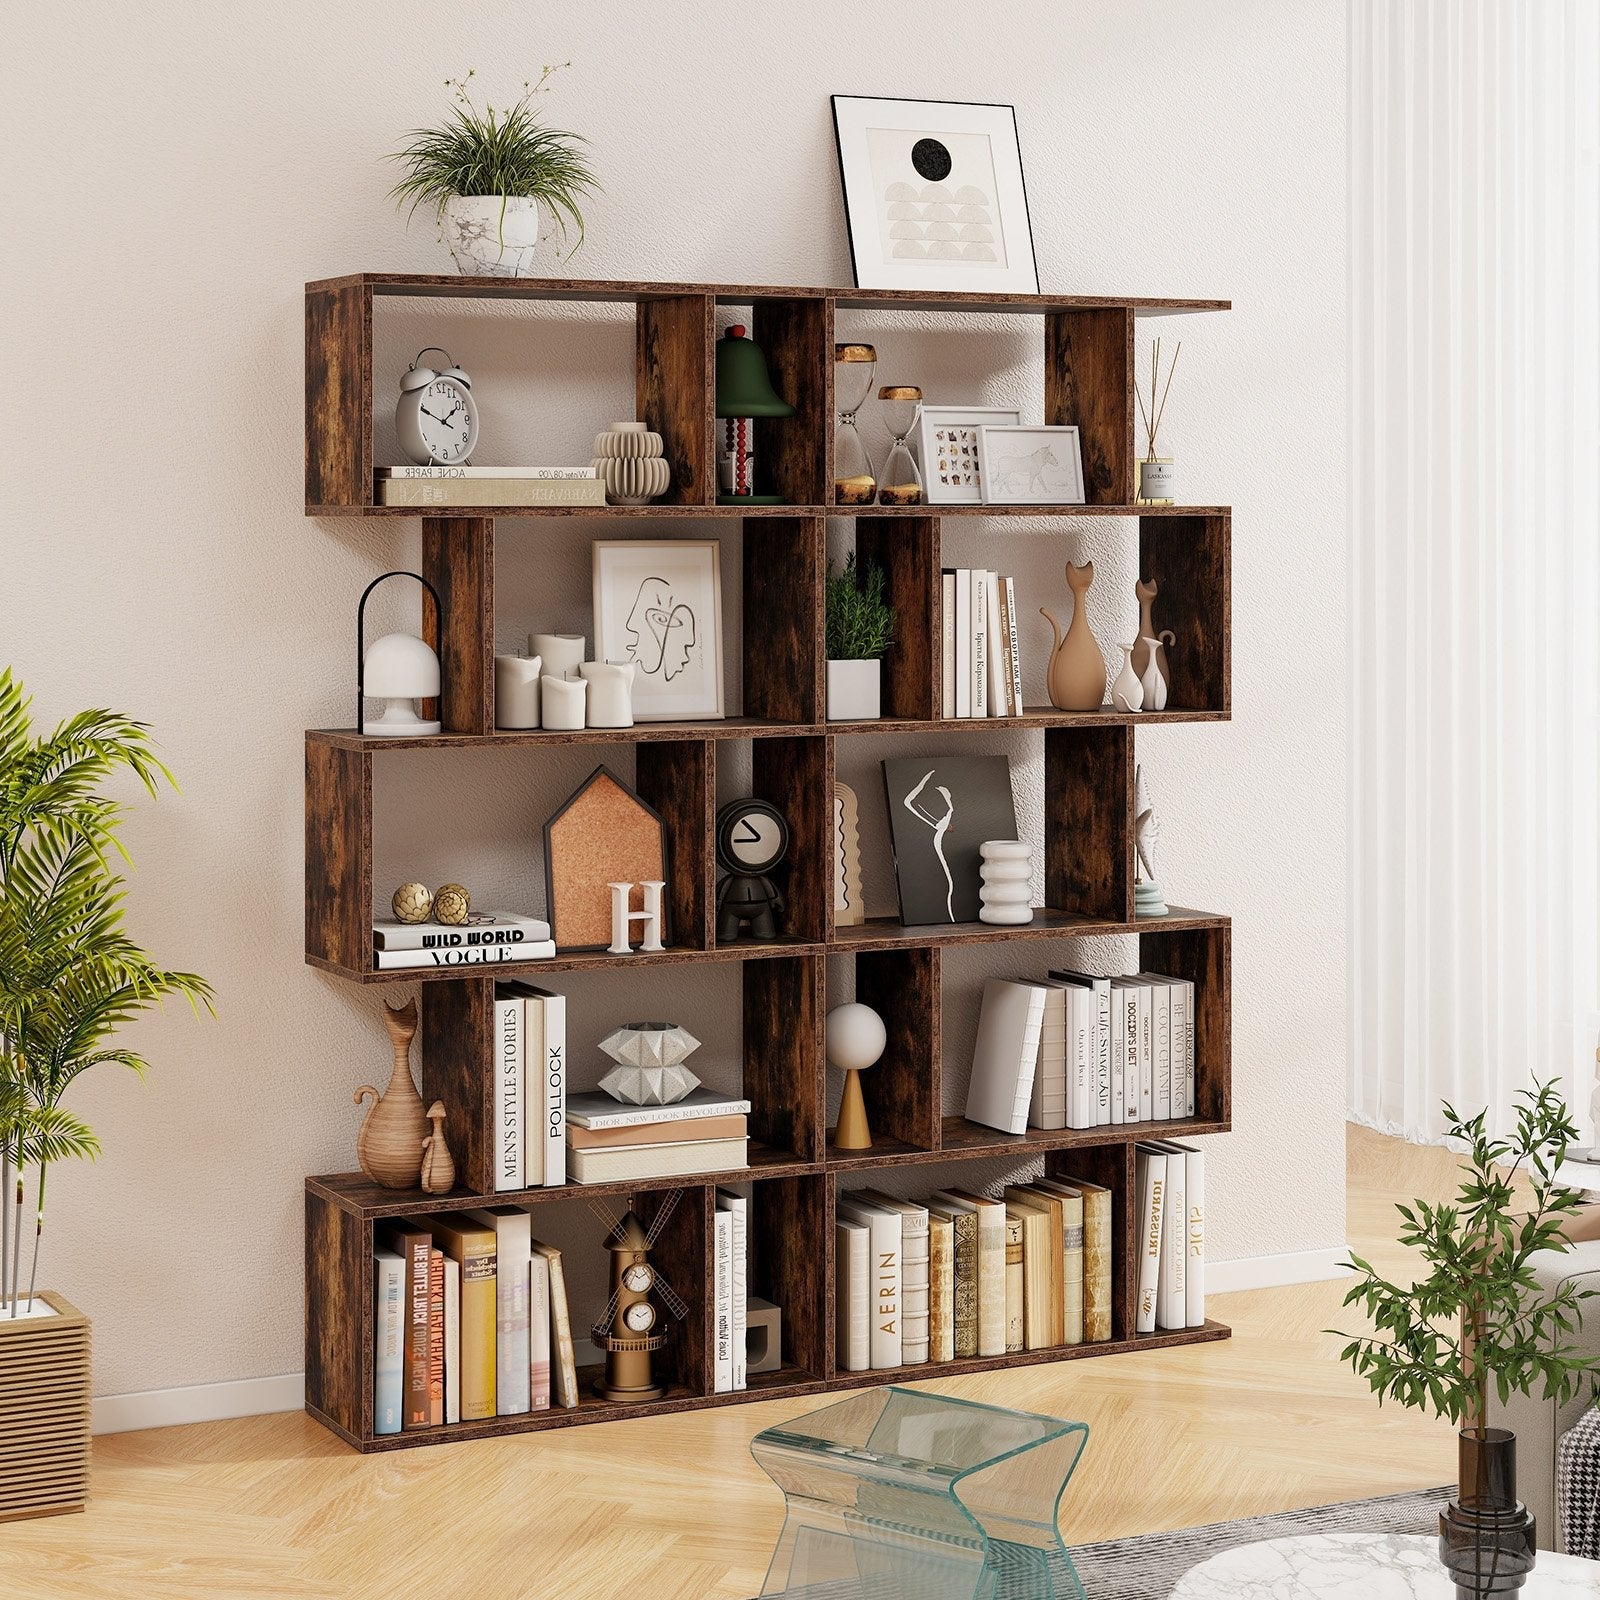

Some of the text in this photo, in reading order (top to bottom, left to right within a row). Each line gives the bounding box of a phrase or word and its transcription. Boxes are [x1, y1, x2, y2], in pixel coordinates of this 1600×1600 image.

[1010, 624, 1018, 662] ГОВОРИ
[975, 632, 984, 708] Братья Карамазовы
[606, 881, 666, 953] H
[422, 929, 524, 948] WILD WORLD
[430, 946, 513, 966] VOGUE
[1174, 1003, 1184, 1018] BE
[1128, 1047, 1136, 1067] DIET
[1174, 1023, 1184, 1053] TWO
[504, 1008, 516, 1178] MEN'S STYLE STORIES
[550, 1046, 562, 1138] POLLOCK
[1158, 1049, 1169, 1104] CHANEL
[626, 1116, 648, 1124] NEW
[651, 1112, 680, 1122] LOOK
[682, 1104, 747, 1118] REVOLUTION
[880, 1252, 896, 1334] AERIN
